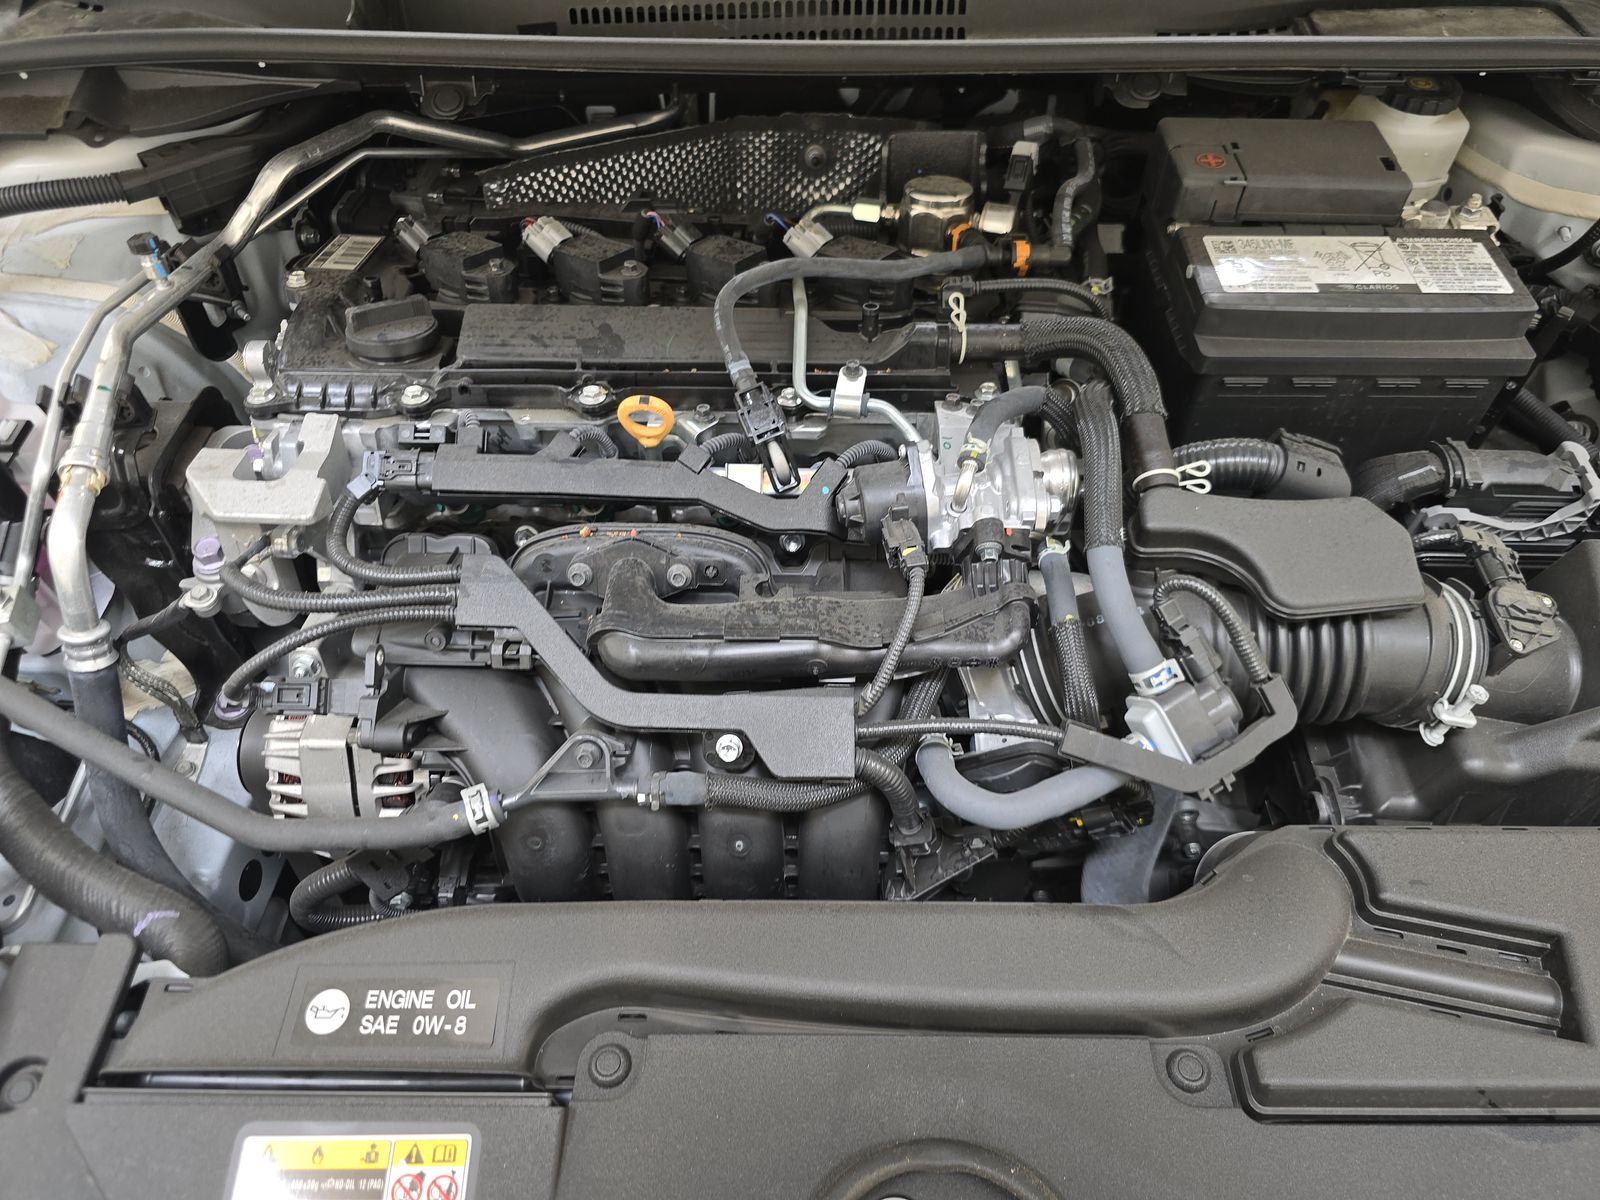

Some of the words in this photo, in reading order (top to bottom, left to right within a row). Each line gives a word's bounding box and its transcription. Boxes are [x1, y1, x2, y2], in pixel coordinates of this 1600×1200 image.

[365, 989, 434, 1009] ENGINE
[446, 989, 476, 1009] OIL
[359, 1015, 400, 1035] SAE
[411, 1015, 467, 1035] 0W-8
